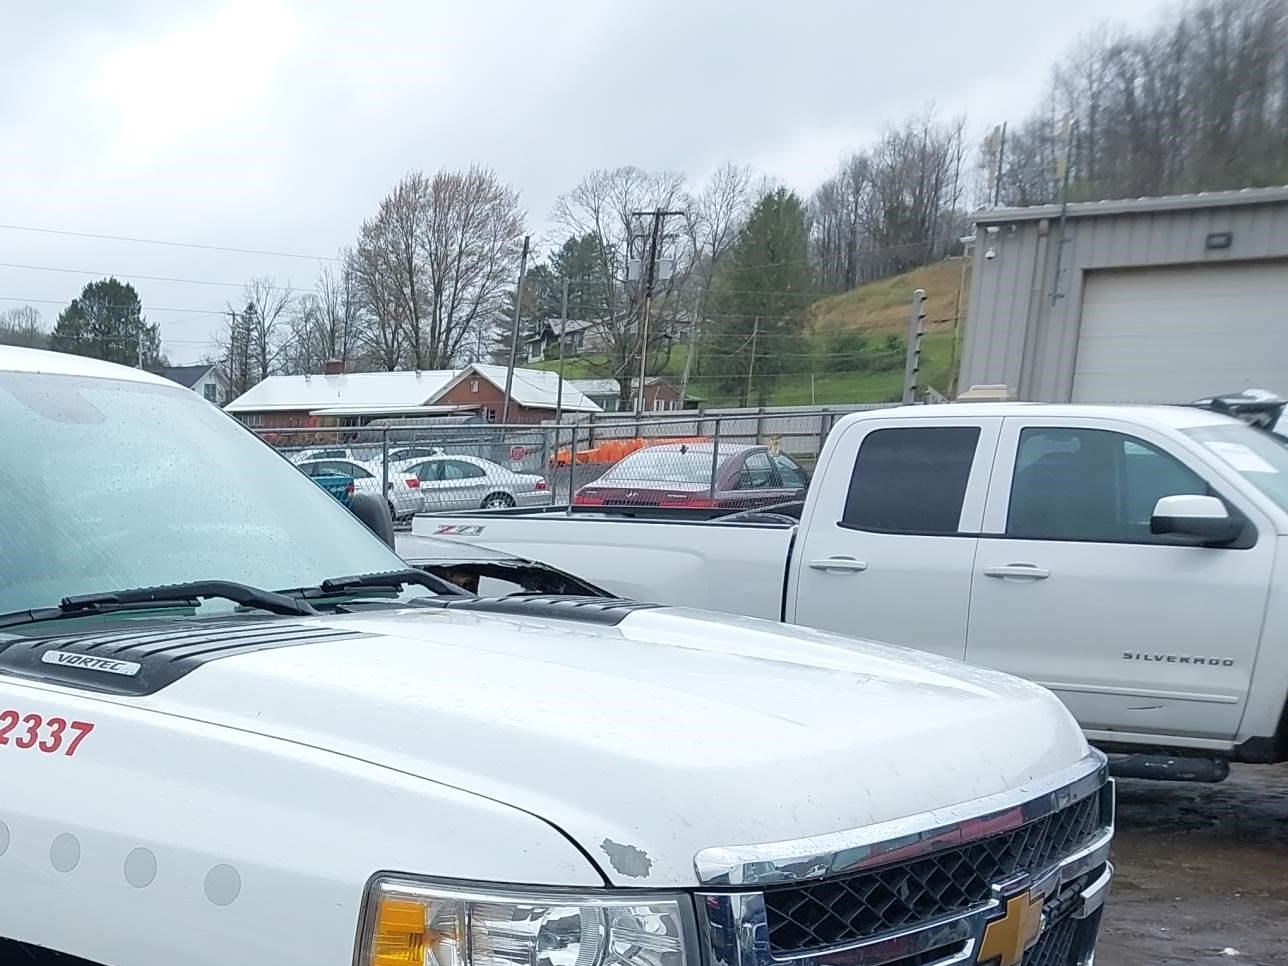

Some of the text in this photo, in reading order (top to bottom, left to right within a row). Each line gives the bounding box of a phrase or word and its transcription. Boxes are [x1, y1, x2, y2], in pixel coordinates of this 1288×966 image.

[432, 523, 487, 537] Z71
[57, 653, 127, 671] VORTEC
[1121, 651, 1235, 667] SILVERADO
